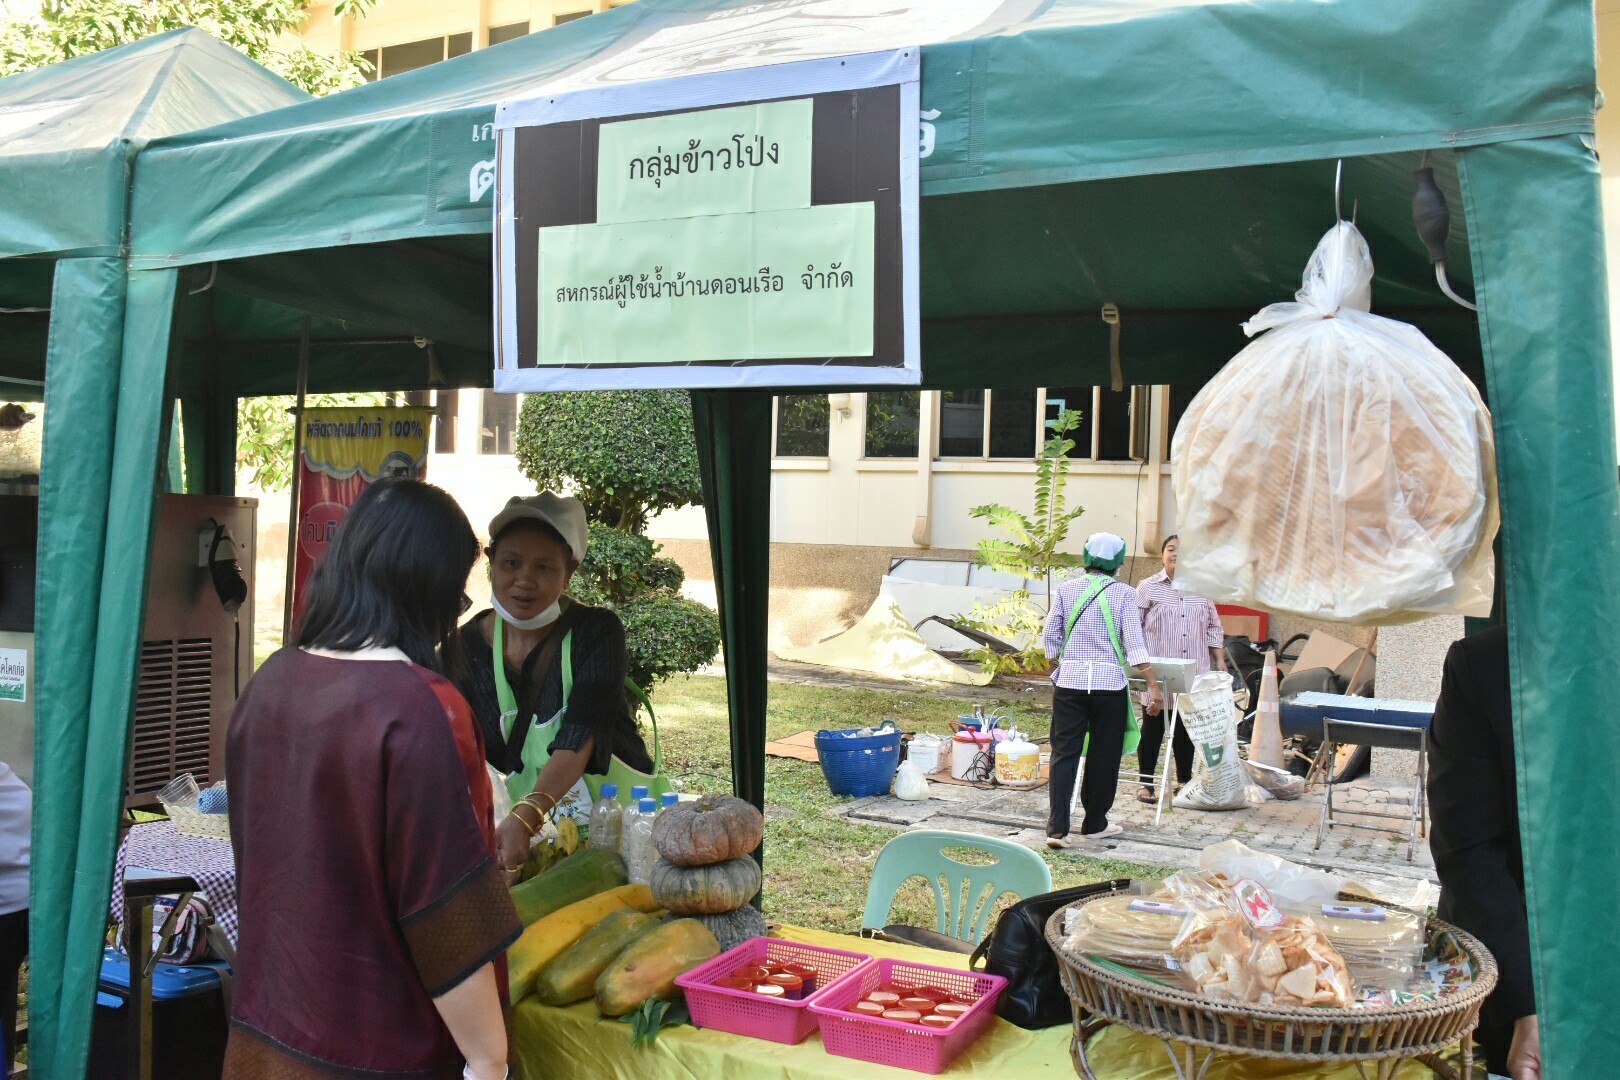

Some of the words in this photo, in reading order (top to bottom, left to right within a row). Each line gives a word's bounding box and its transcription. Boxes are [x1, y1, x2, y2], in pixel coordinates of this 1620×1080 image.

[629, 134, 780, 189] กลุ่มข้าวโป่ง
[556, 265, 784, 308] สหกรณ์ผู้ใช้น้ำบ้านดอนเรือ
[801, 262, 853, 290] จำกัด
[388, 420, 423, 438] 100%
